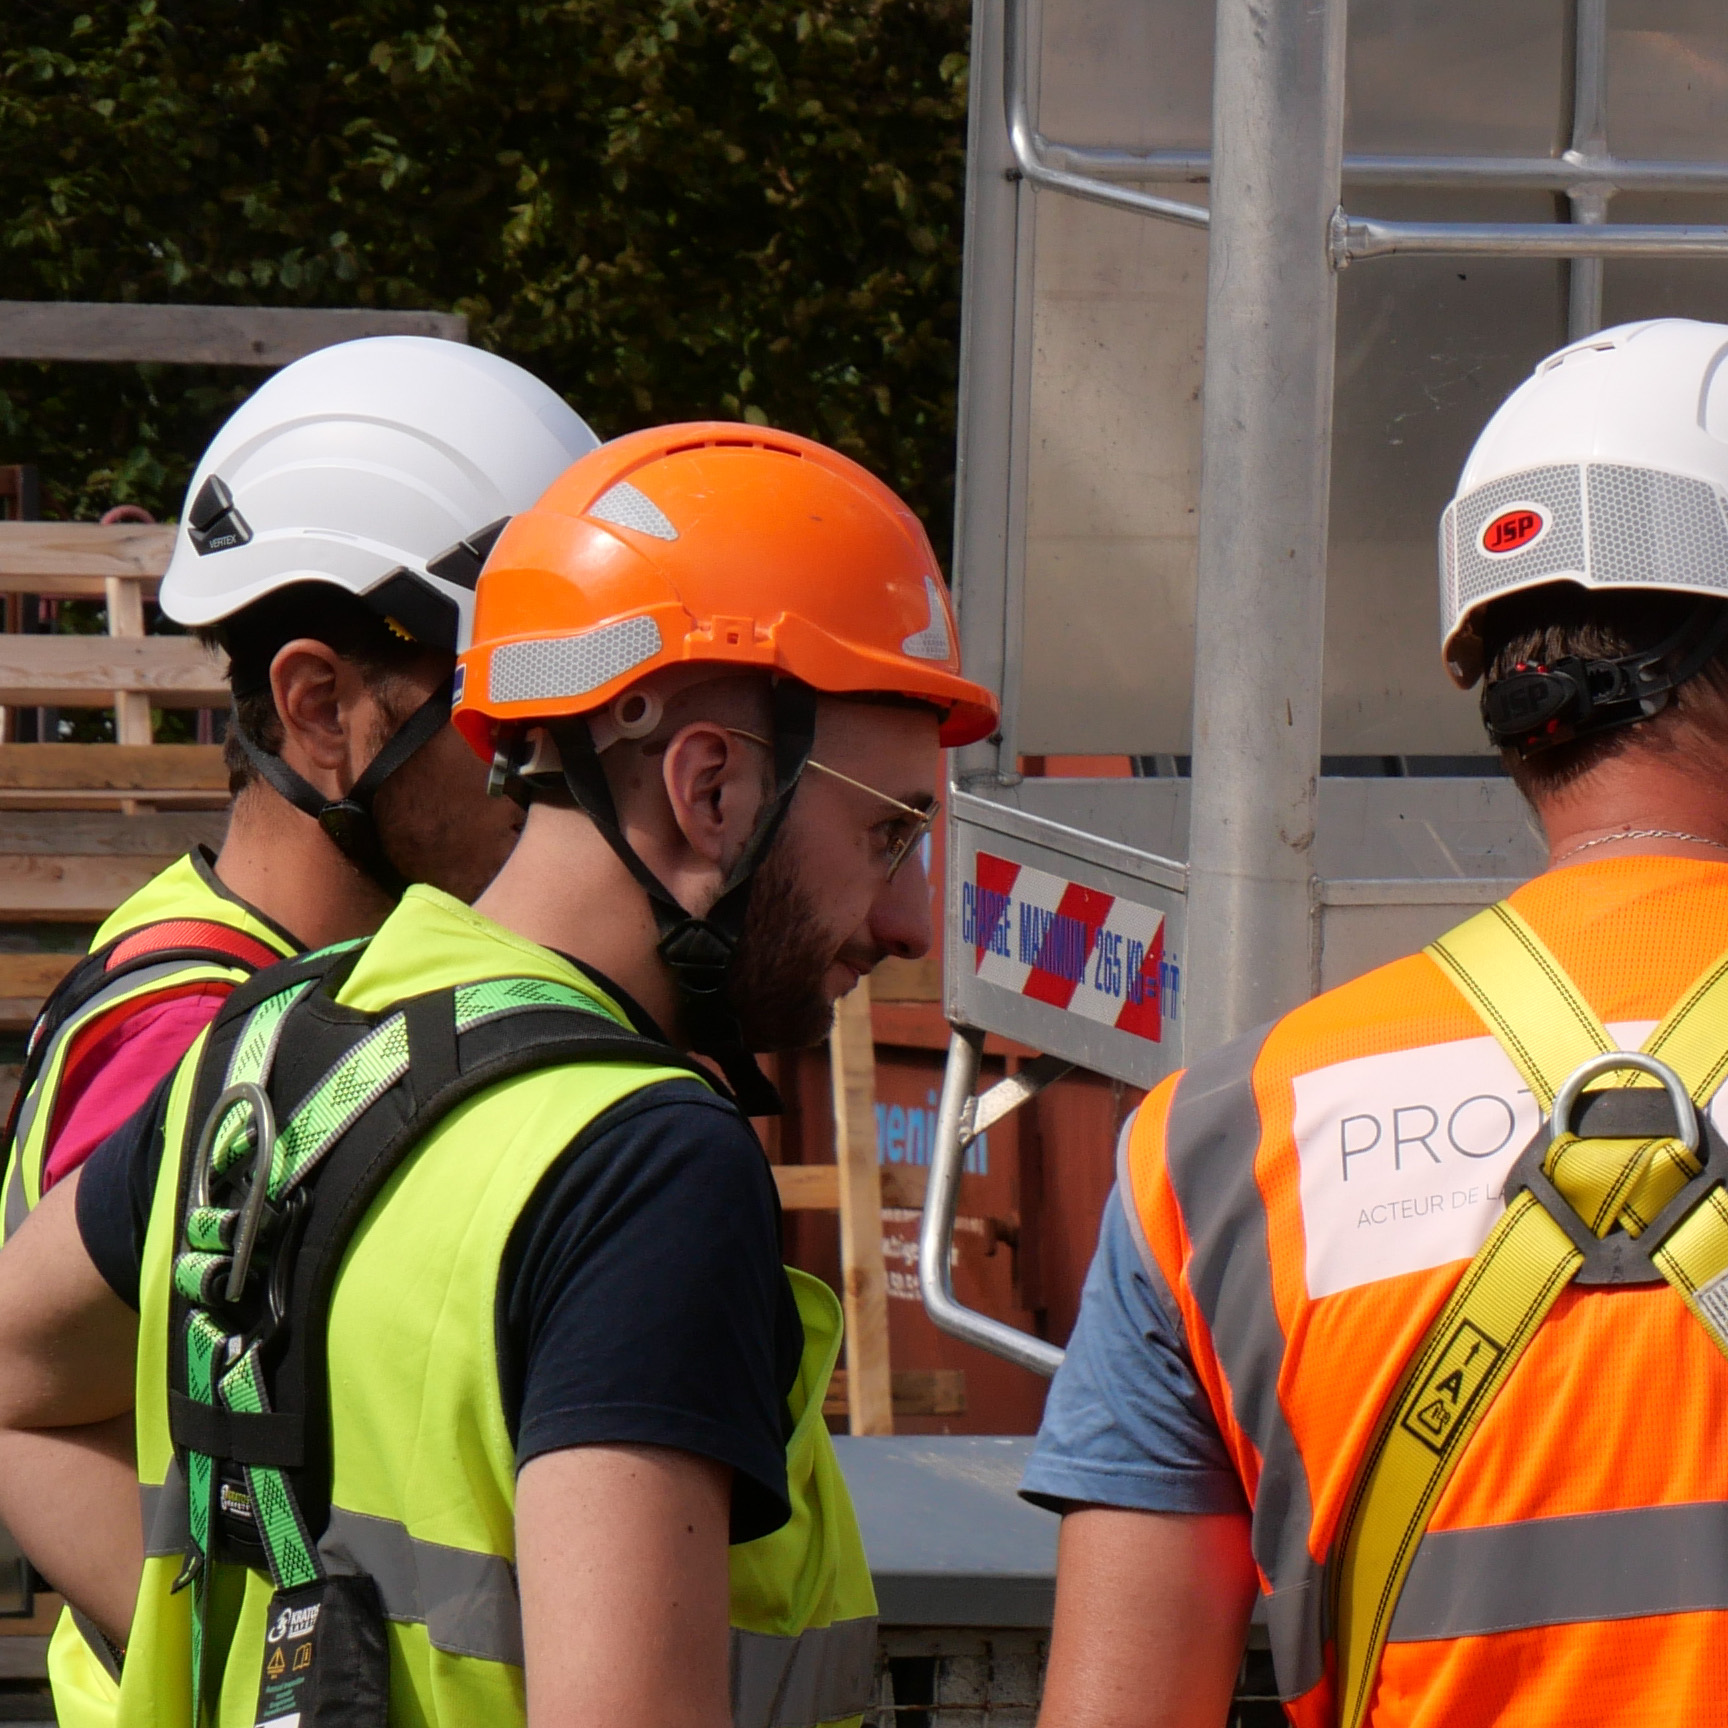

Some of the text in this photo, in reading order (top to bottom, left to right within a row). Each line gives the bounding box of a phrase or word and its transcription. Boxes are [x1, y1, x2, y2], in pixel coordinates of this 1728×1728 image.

[208, 534, 237, 549] VERTEX
[1492, 515, 1534, 547] JSP
[962, 880, 1011, 957] CHARGE
[1095, 926, 1122, 998] 265
[1126, 937, 1143, 1005] KG
[1357, 1195, 1445, 1228] ACTEUR
[1452, 1187, 1479, 1209] DE
[1434, 1368, 1464, 1406] A
